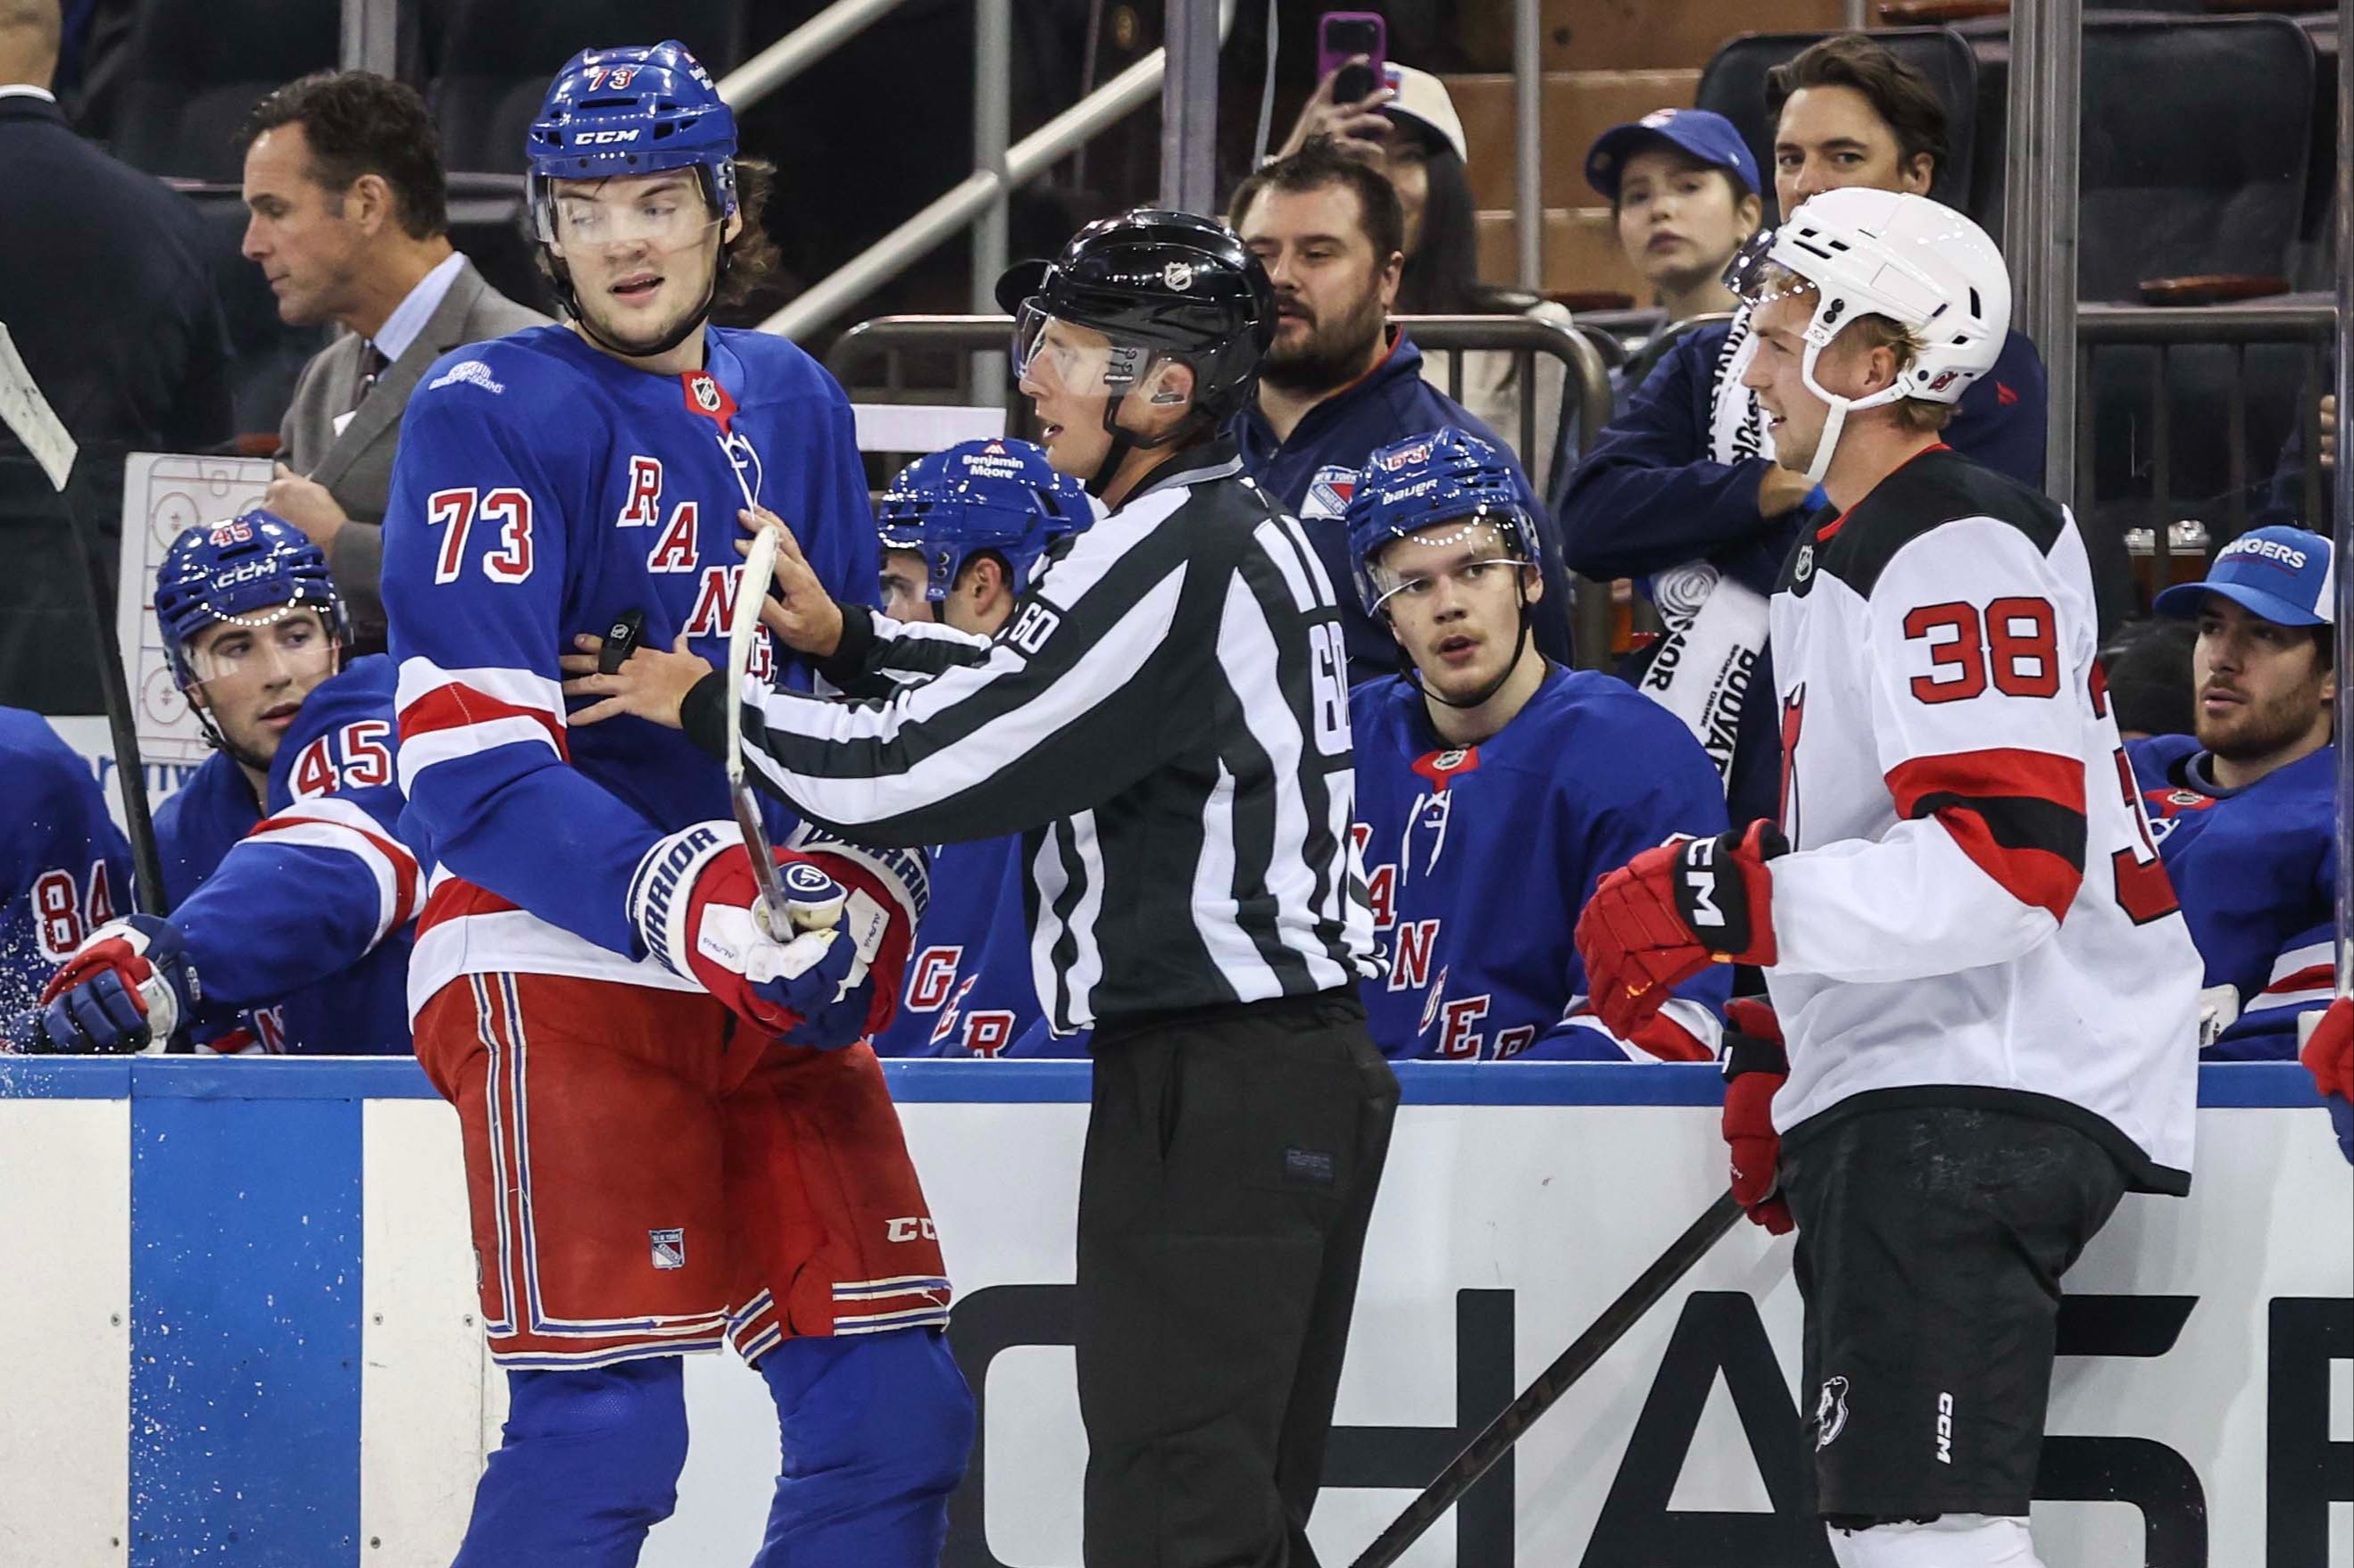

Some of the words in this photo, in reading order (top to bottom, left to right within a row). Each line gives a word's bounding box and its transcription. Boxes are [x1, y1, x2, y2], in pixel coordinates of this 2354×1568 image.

[587, 68, 634, 93] 73
[574, 129, 640, 145] CCM
[961, 453, 1025, 470] Benjamin
[969, 463, 1016, 479] Moore
[208, 521, 253, 548] 45
[427, 486, 534, 585] 73
[216, 560, 277, 589] CCM
[616, 455, 777, 684] RANG
[1009, 601, 1061, 655] 60
[1902, 596, 2061, 705] 38
[1309, 620, 1354, 757] 60
[288, 719, 393, 799] 45
[30, 859, 116, 964] 84
[1685, 835, 1726, 927] CM
[884, 1215, 937, 1243] CC
[1936, 1390, 1954, 1465] CCM
